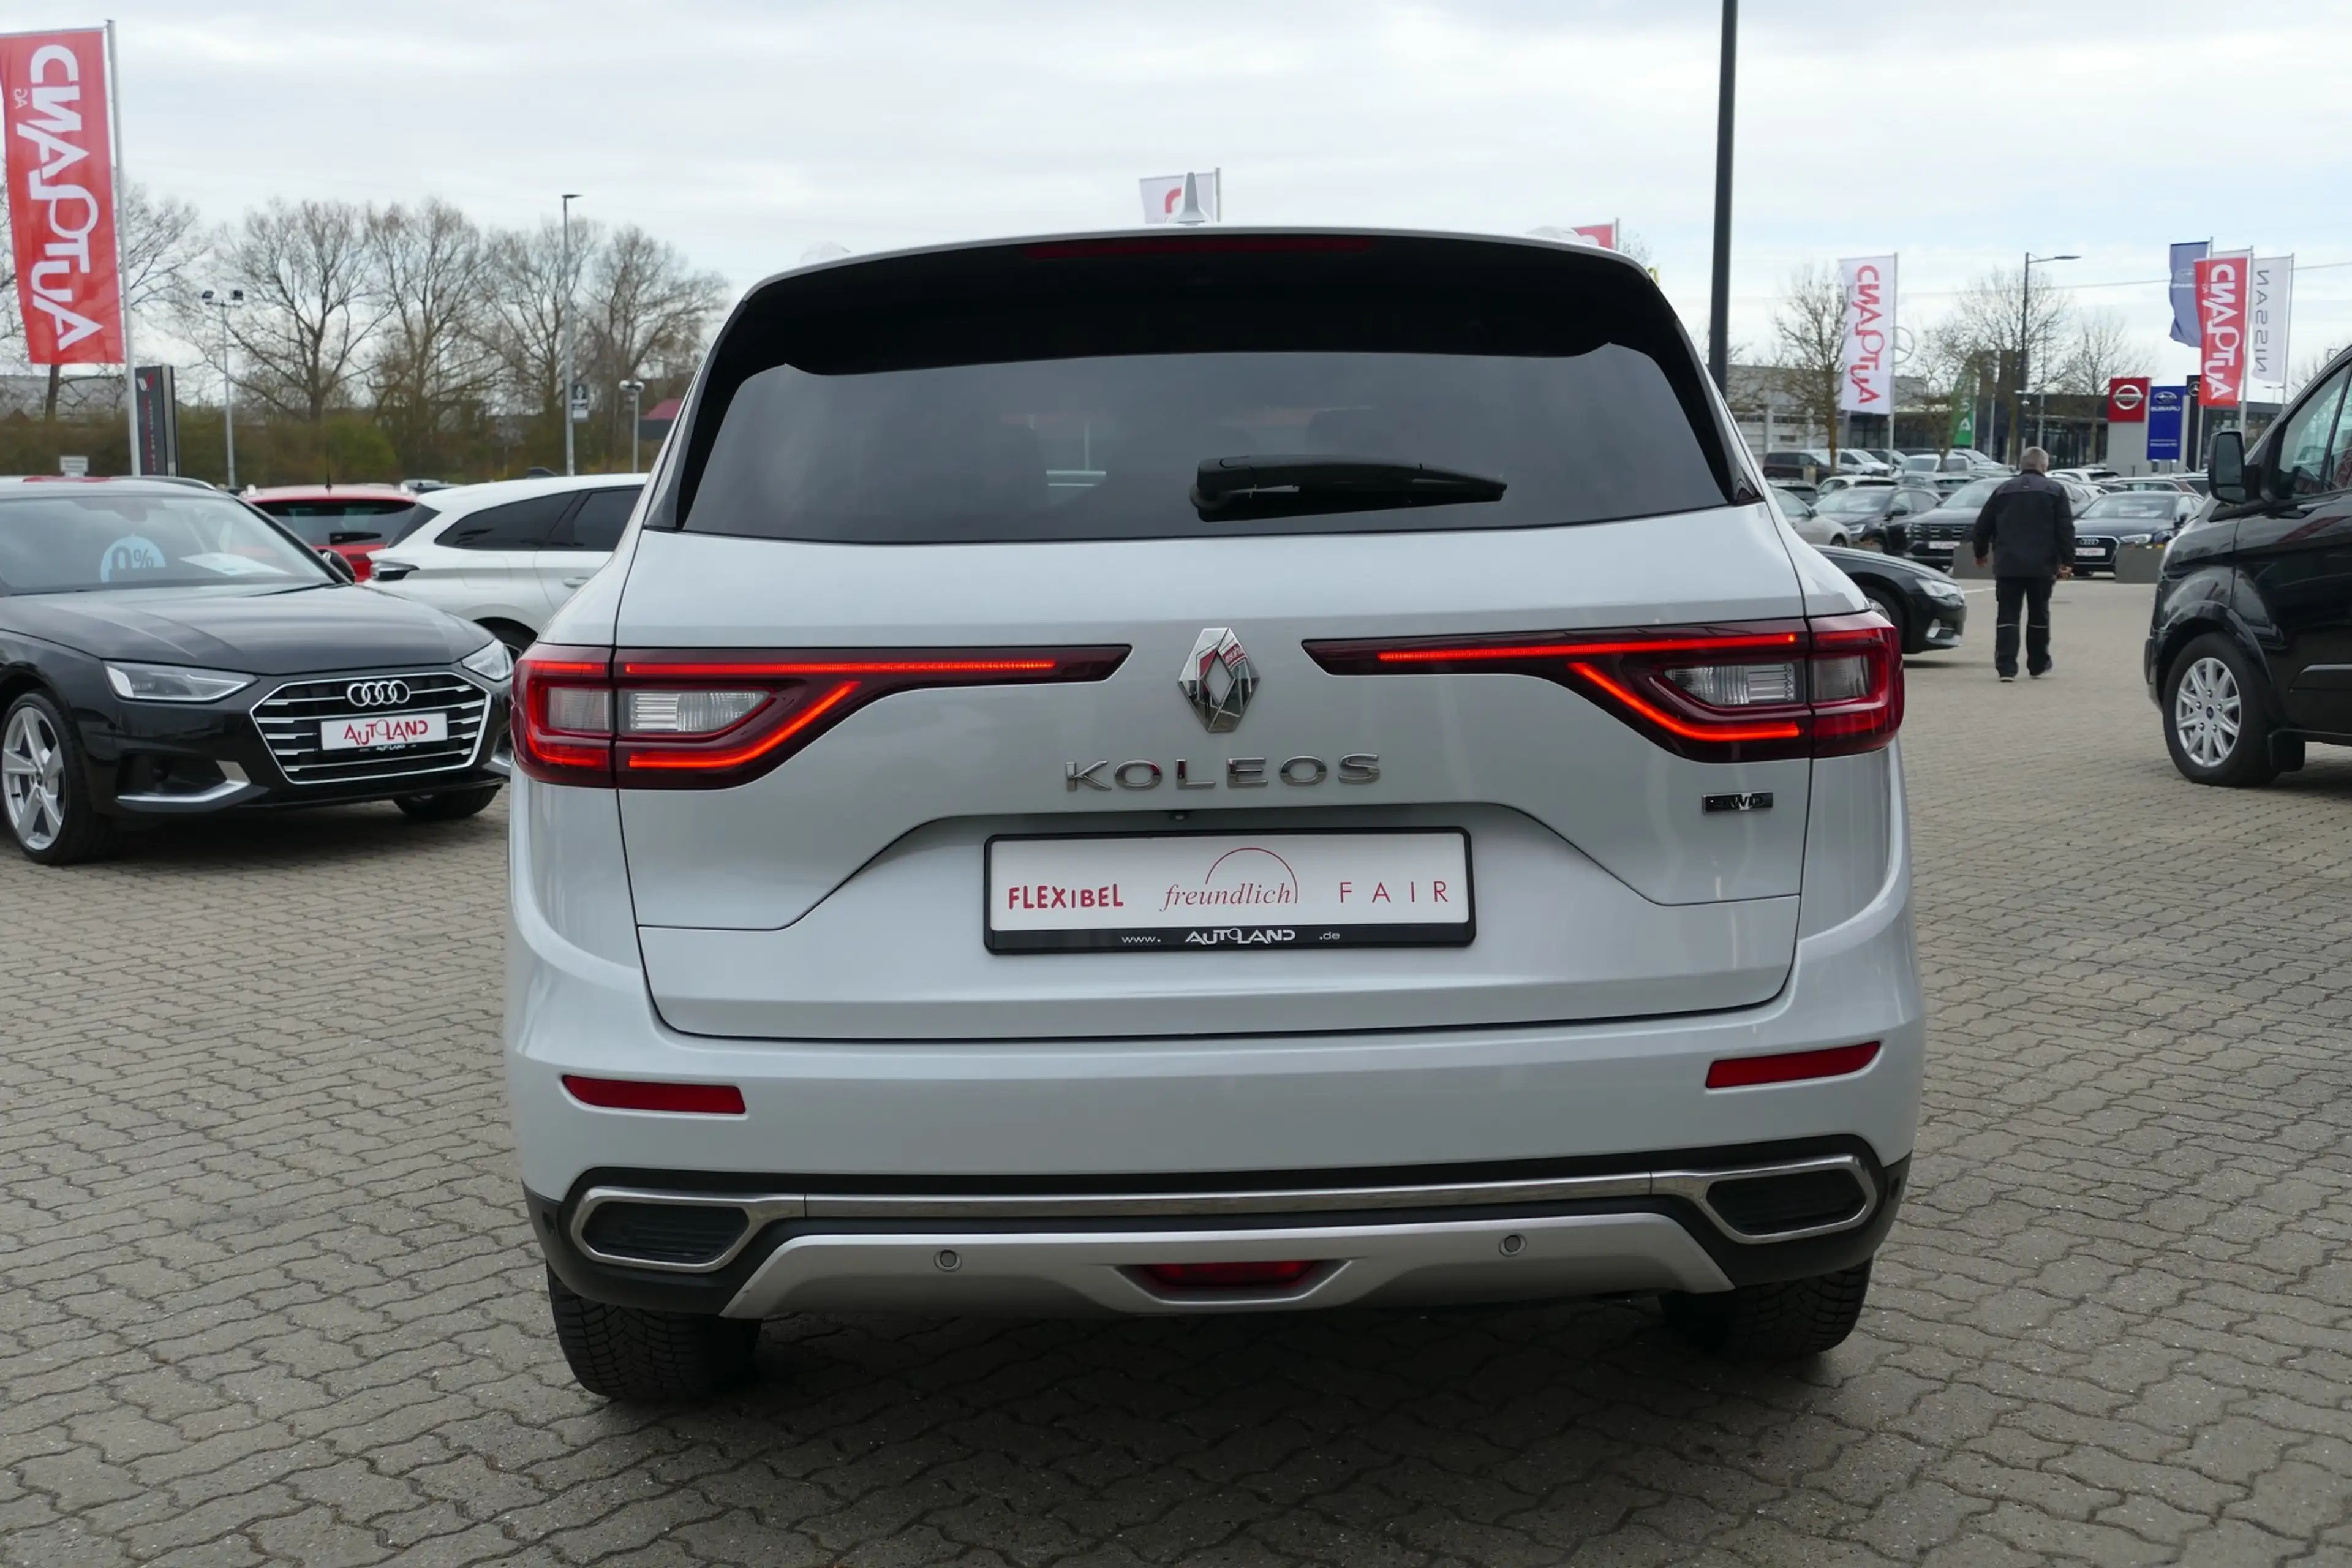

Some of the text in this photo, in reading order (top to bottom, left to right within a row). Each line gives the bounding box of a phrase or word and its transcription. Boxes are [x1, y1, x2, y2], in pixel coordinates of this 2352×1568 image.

[344, 719, 428, 745] AUTOLAND
[1065, 753, 1381, 792] KOLEOS
[1008, 880, 1449, 911] FLEXIBEL freundlich FAIR
[1121, 927, 1340, 945] www. AUTOLAND .de
